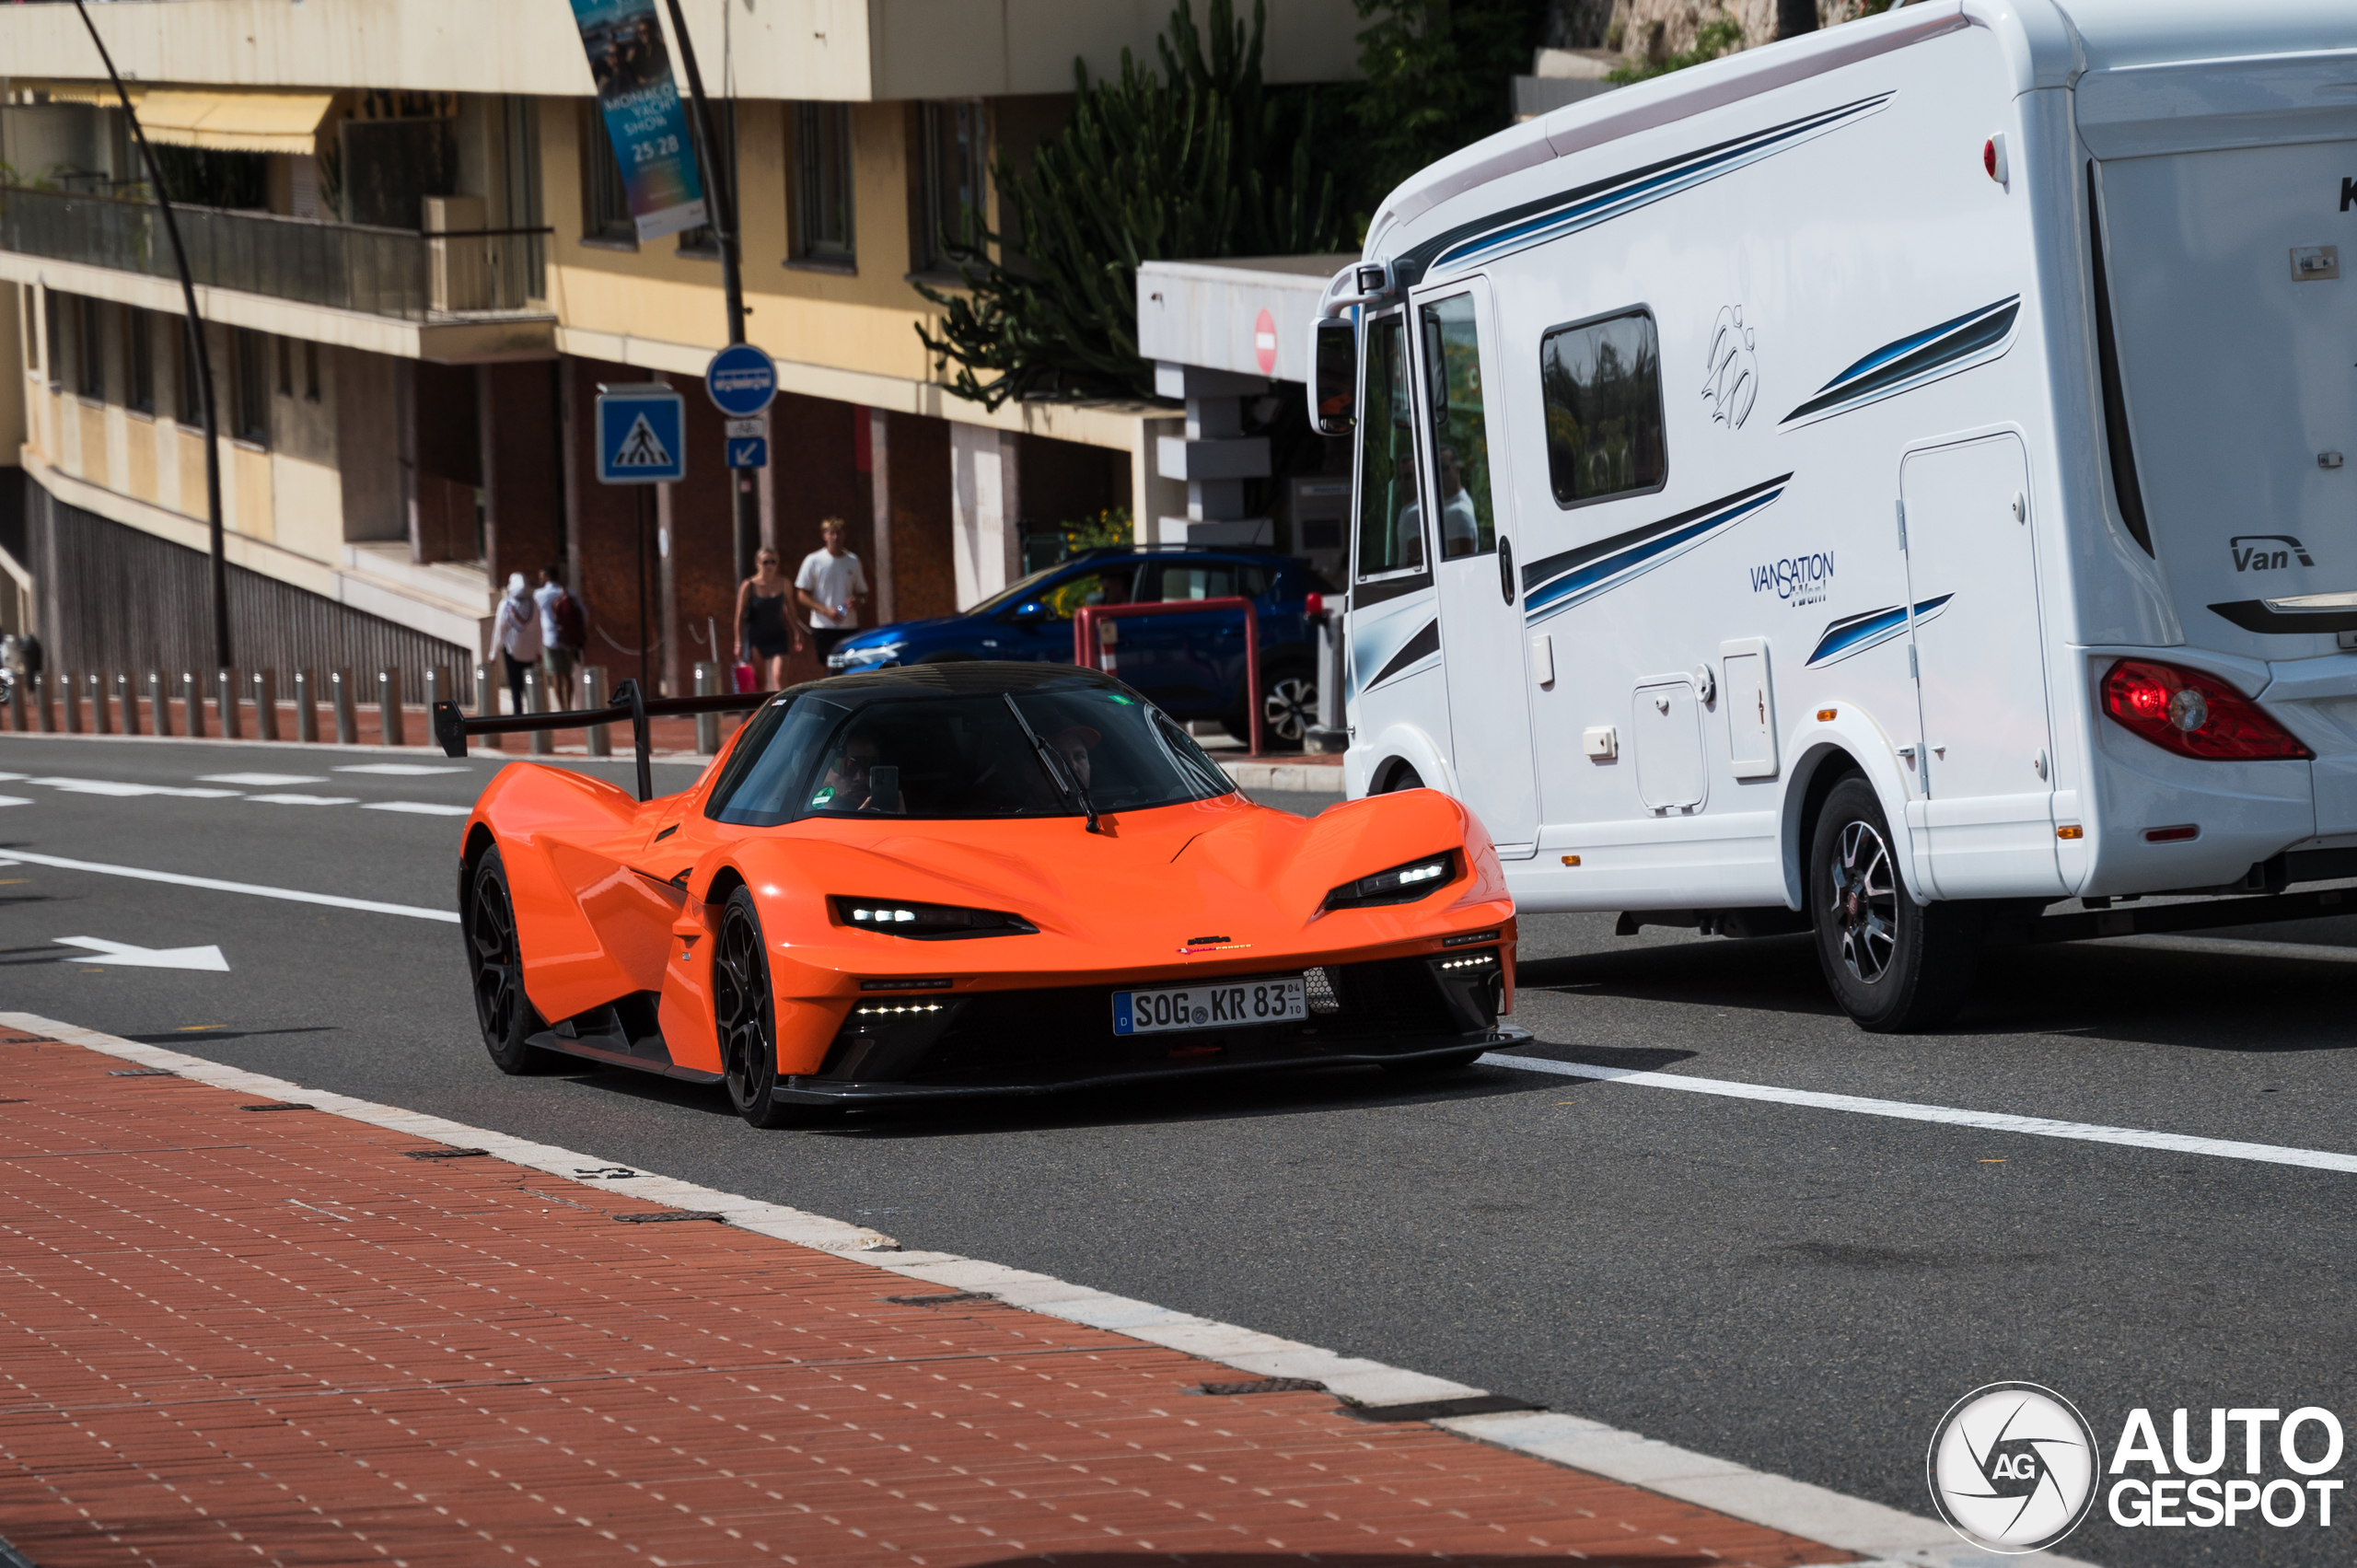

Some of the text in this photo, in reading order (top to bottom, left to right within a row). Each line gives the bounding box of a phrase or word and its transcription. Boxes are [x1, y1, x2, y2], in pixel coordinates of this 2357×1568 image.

[603, 82, 674, 112] MONACO
[630, 96, 676, 119] YACHT
[623, 114, 668, 136] SHOW
[632, 134, 679, 162] 25 28
[2232, 547, 2288, 572] Van
[1750, 551, 1834, 599] VANSATION
[1287, 983, 1300, 993] 04
[1135, 984, 1286, 1027] SOG KR 83
[1290, 1005, 1301, 1015] 10
[1120, 1017, 1128, 1027] D
